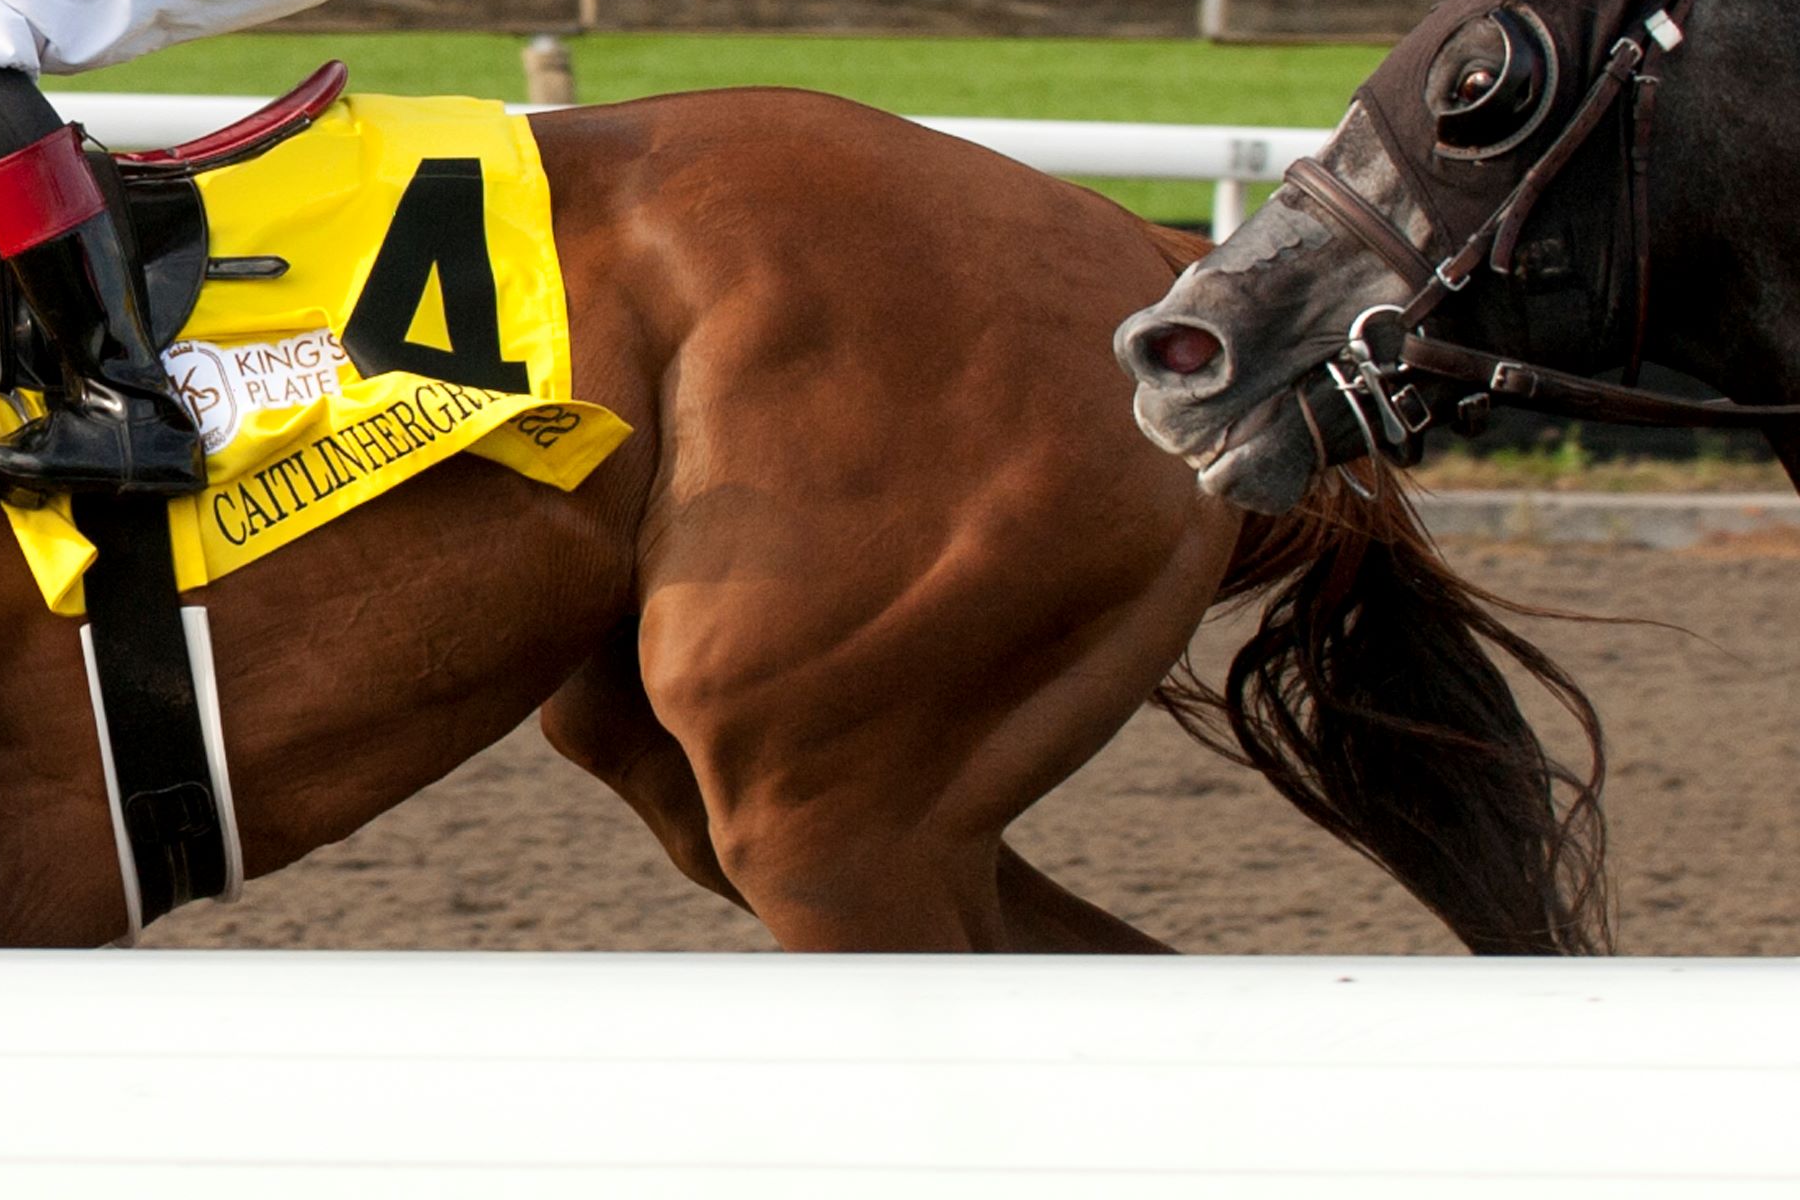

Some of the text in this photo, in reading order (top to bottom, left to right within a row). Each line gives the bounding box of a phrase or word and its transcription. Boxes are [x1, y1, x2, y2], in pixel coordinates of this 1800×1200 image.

[340, 157, 531, 396] 4
[234, 332, 347, 377] KING'S
[245, 369, 334, 405] PLATE
